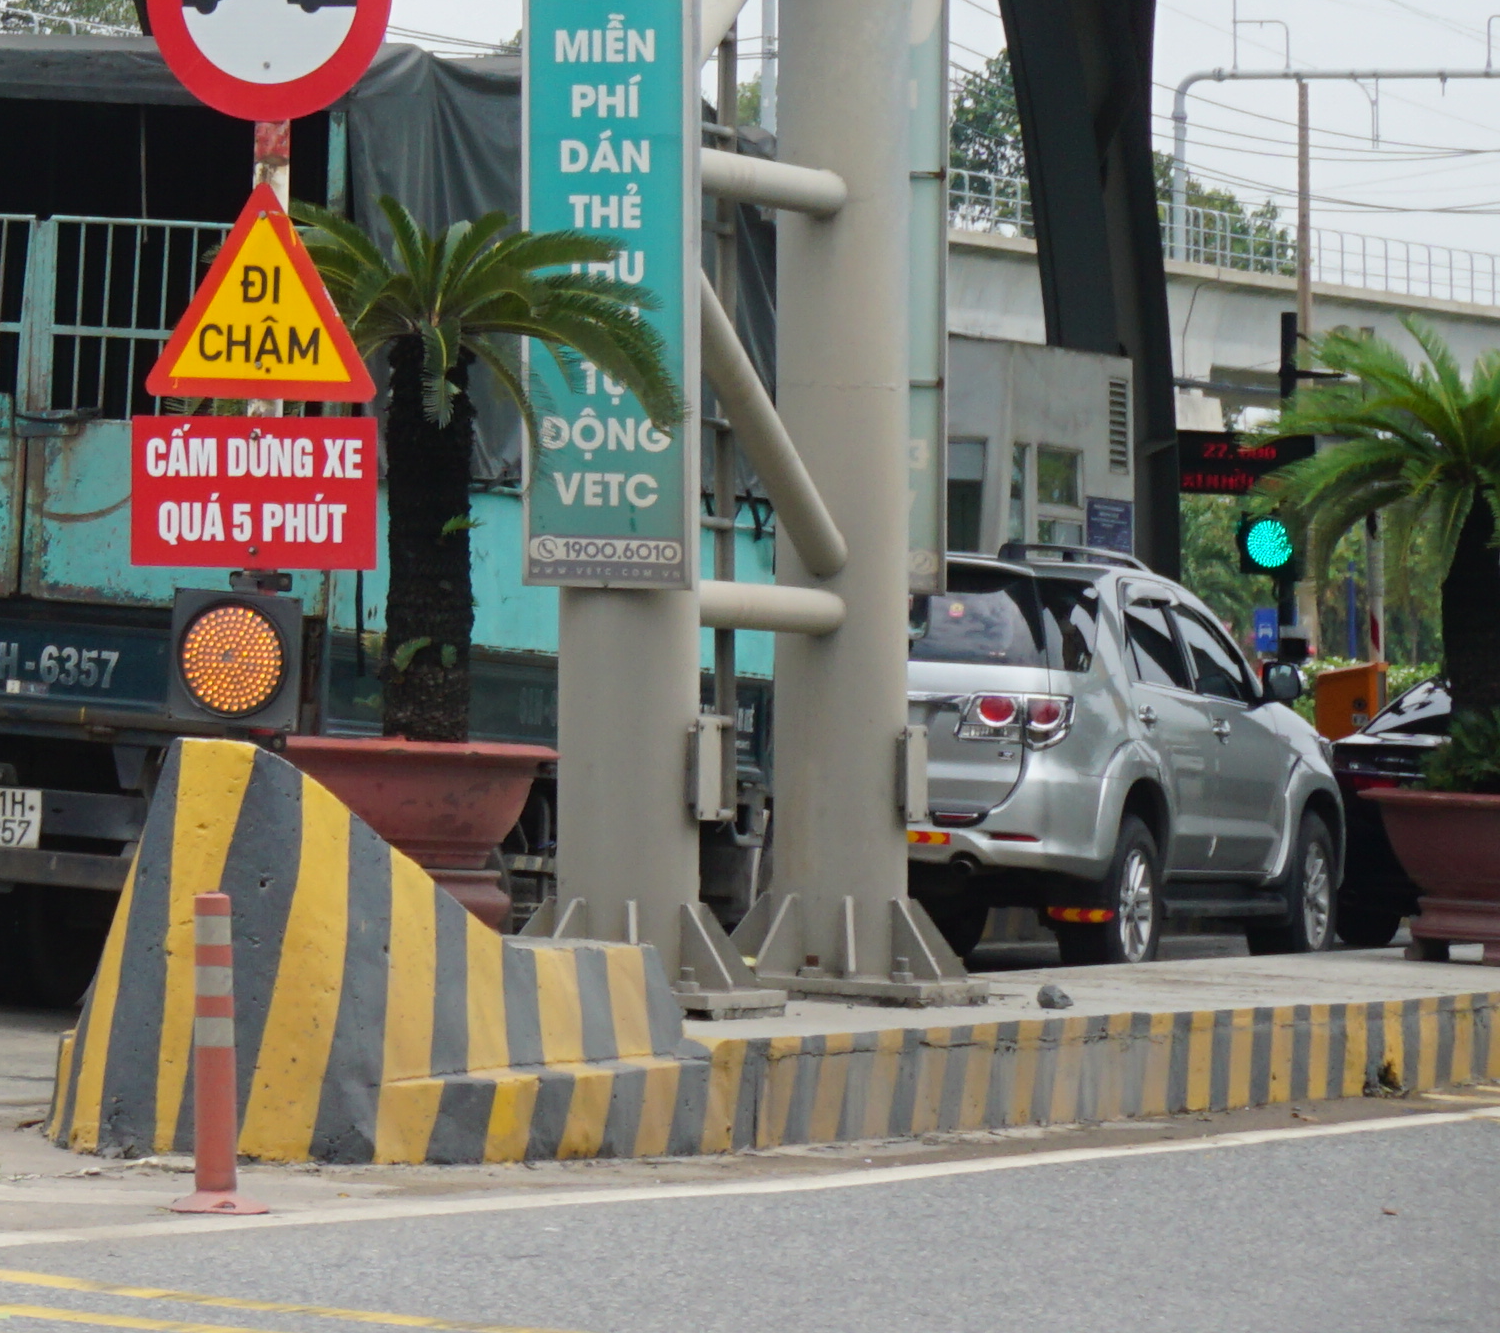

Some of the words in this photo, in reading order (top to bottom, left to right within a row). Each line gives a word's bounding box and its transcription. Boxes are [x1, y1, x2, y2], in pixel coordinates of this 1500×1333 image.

[555, 13, 655, 63] MIỄN
[571, 73, 641, 118] PHÍ
[560, 129, 650, 173] DÁN
[568, 183, 641, 228] THẺ
[240, 265, 281, 305] ĐI
[198, 316, 321, 374] CHẬM
[146, 423, 218, 477] CẤM
[227, 427, 314, 479] DỪNG
[323, 439, 363, 479] XE
[553, 471, 659, 508] VETC
[158, 492, 225, 546] QUÁ
[232, 503, 252, 542] 5
[262, 494, 348, 544] PHÚT
[563, 541, 678, 562] 1900.6010
